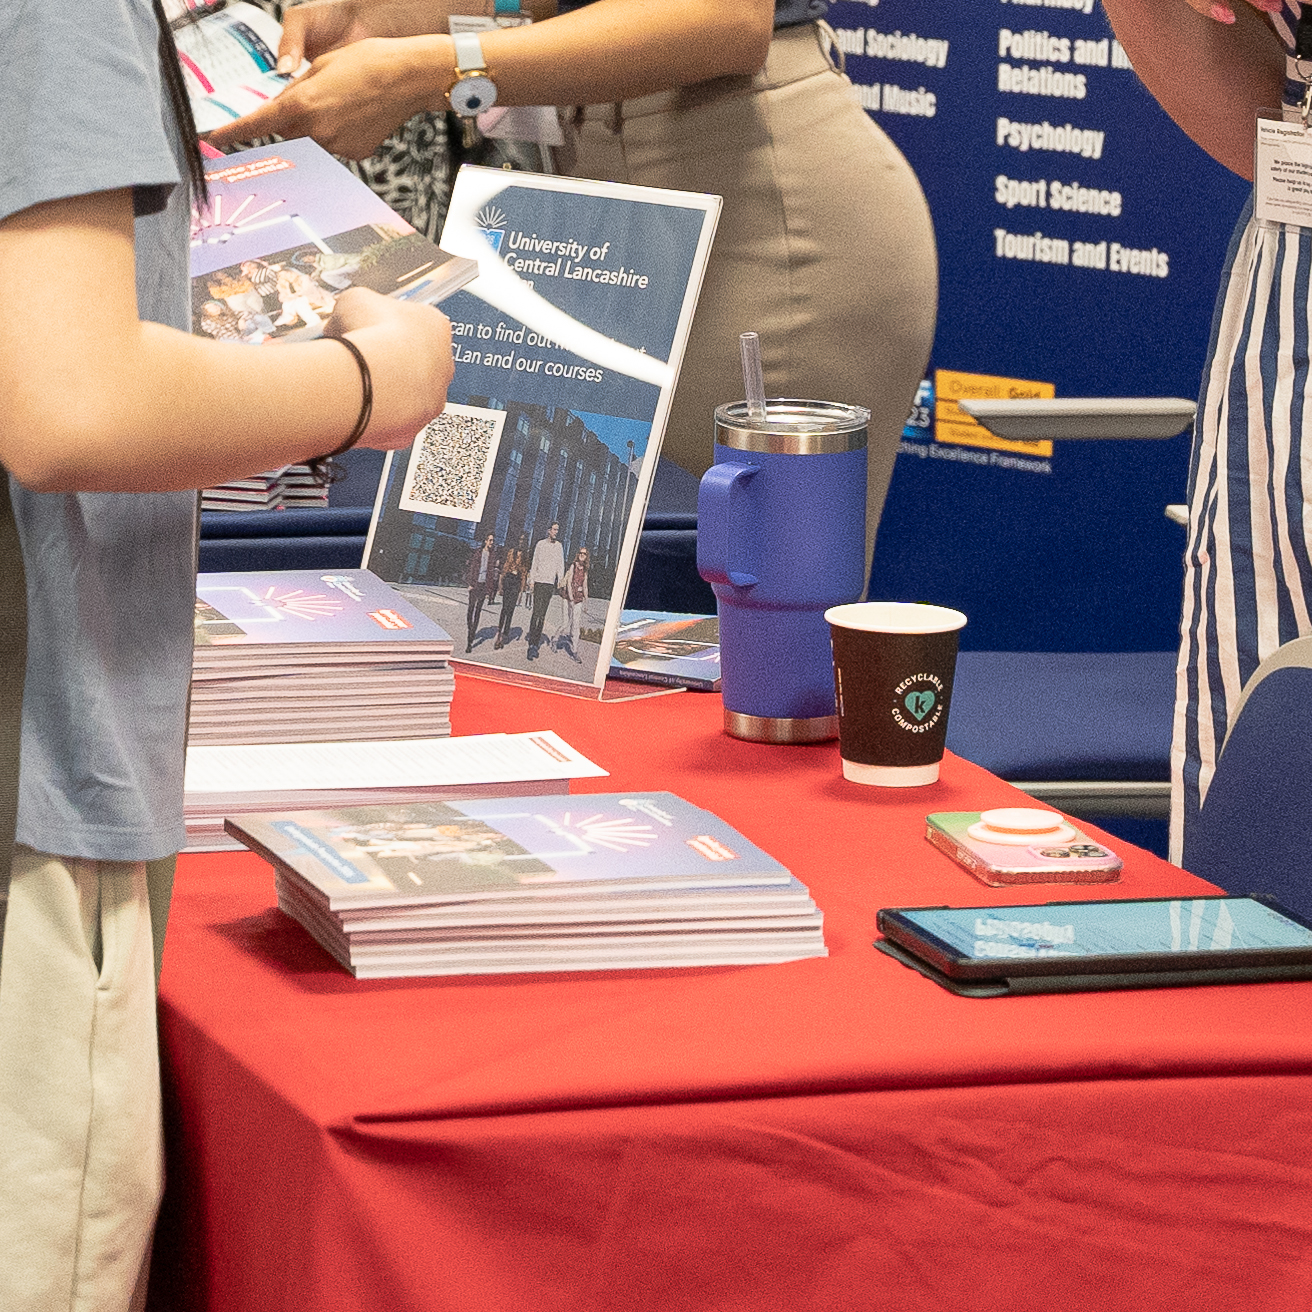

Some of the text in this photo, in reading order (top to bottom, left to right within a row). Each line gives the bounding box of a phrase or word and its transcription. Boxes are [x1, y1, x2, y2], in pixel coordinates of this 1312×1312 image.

[866, 29, 948, 69] Sociology
[999, 28, 1070, 64] Politics
[1073, 37, 1109, 67] and
[997, 63, 1087, 100] Relations
[882, 84, 937, 118] Music
[996, 117, 1104, 160] Psychology
[994, 175, 1122, 217] Sport Science
[508, 231, 609, 262] University of
[994, 228, 1169, 278] Tourism and Events
[504, 253, 561, 276] Central
[564, 261, 649, 289] Lancashire
[450, 321, 473, 337] can
[477, 324, 491, 339] to
[495, 322, 525, 343] find
[484, 352, 512, 369] and
[516, 358, 542, 373] our
[545, 362, 604, 383] courses
[895, 673, 943, 695] RECYCLABLE
[892, 704, 943, 733] COMPOSTABLE
[914, 696, 926, 714] k
